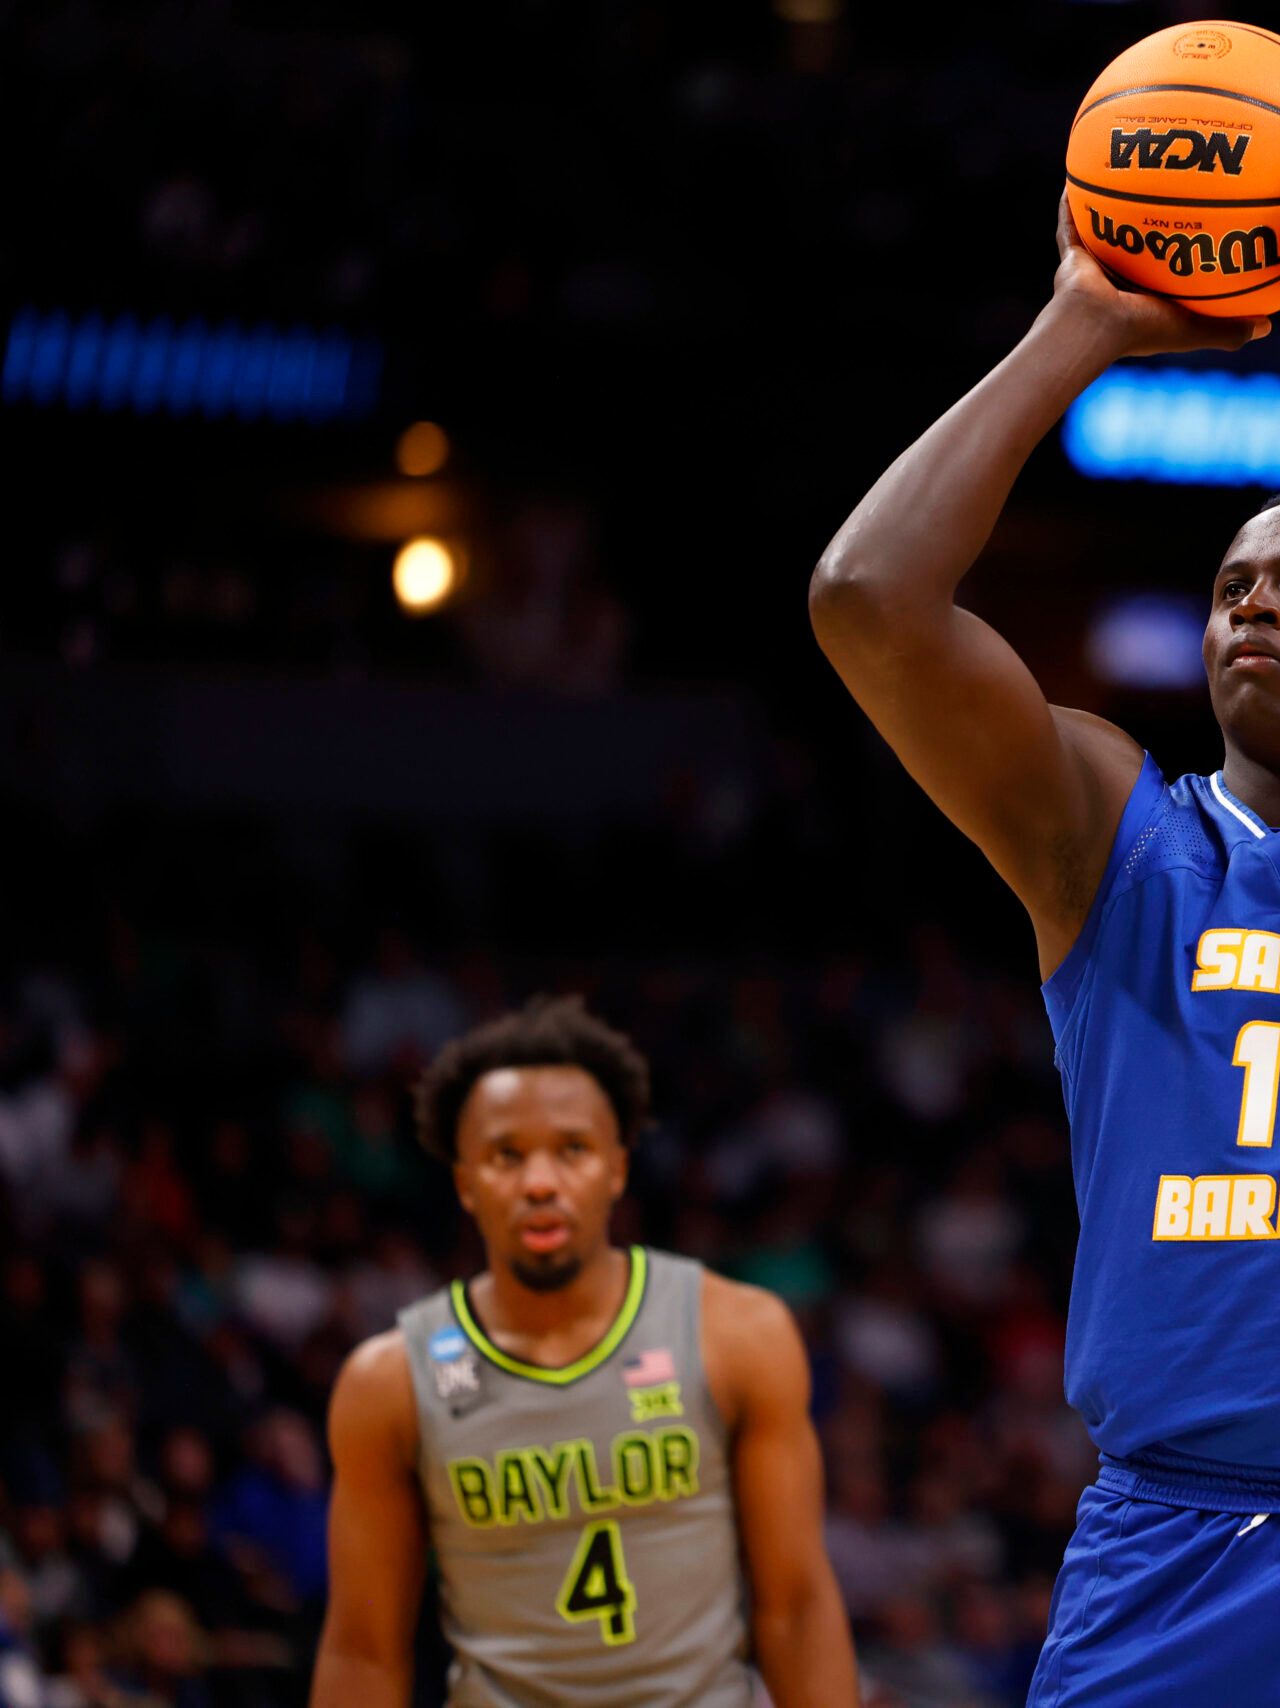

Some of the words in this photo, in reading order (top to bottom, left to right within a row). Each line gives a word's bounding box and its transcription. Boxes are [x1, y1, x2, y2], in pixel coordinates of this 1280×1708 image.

[1115, 115, 1146, 123] BALL
[1148, 116, 1188, 125] GAME
[1191, 118, 1253, 130] OFFICIAL
[1110, 127, 1252, 175] NCAA
[1142, 217, 1170, 229] NXT
[1174, 221, 1203, 230] EVO
[449, 1425, 699, 1529] BAYLOR
[556, 1519, 638, 1646] 4
